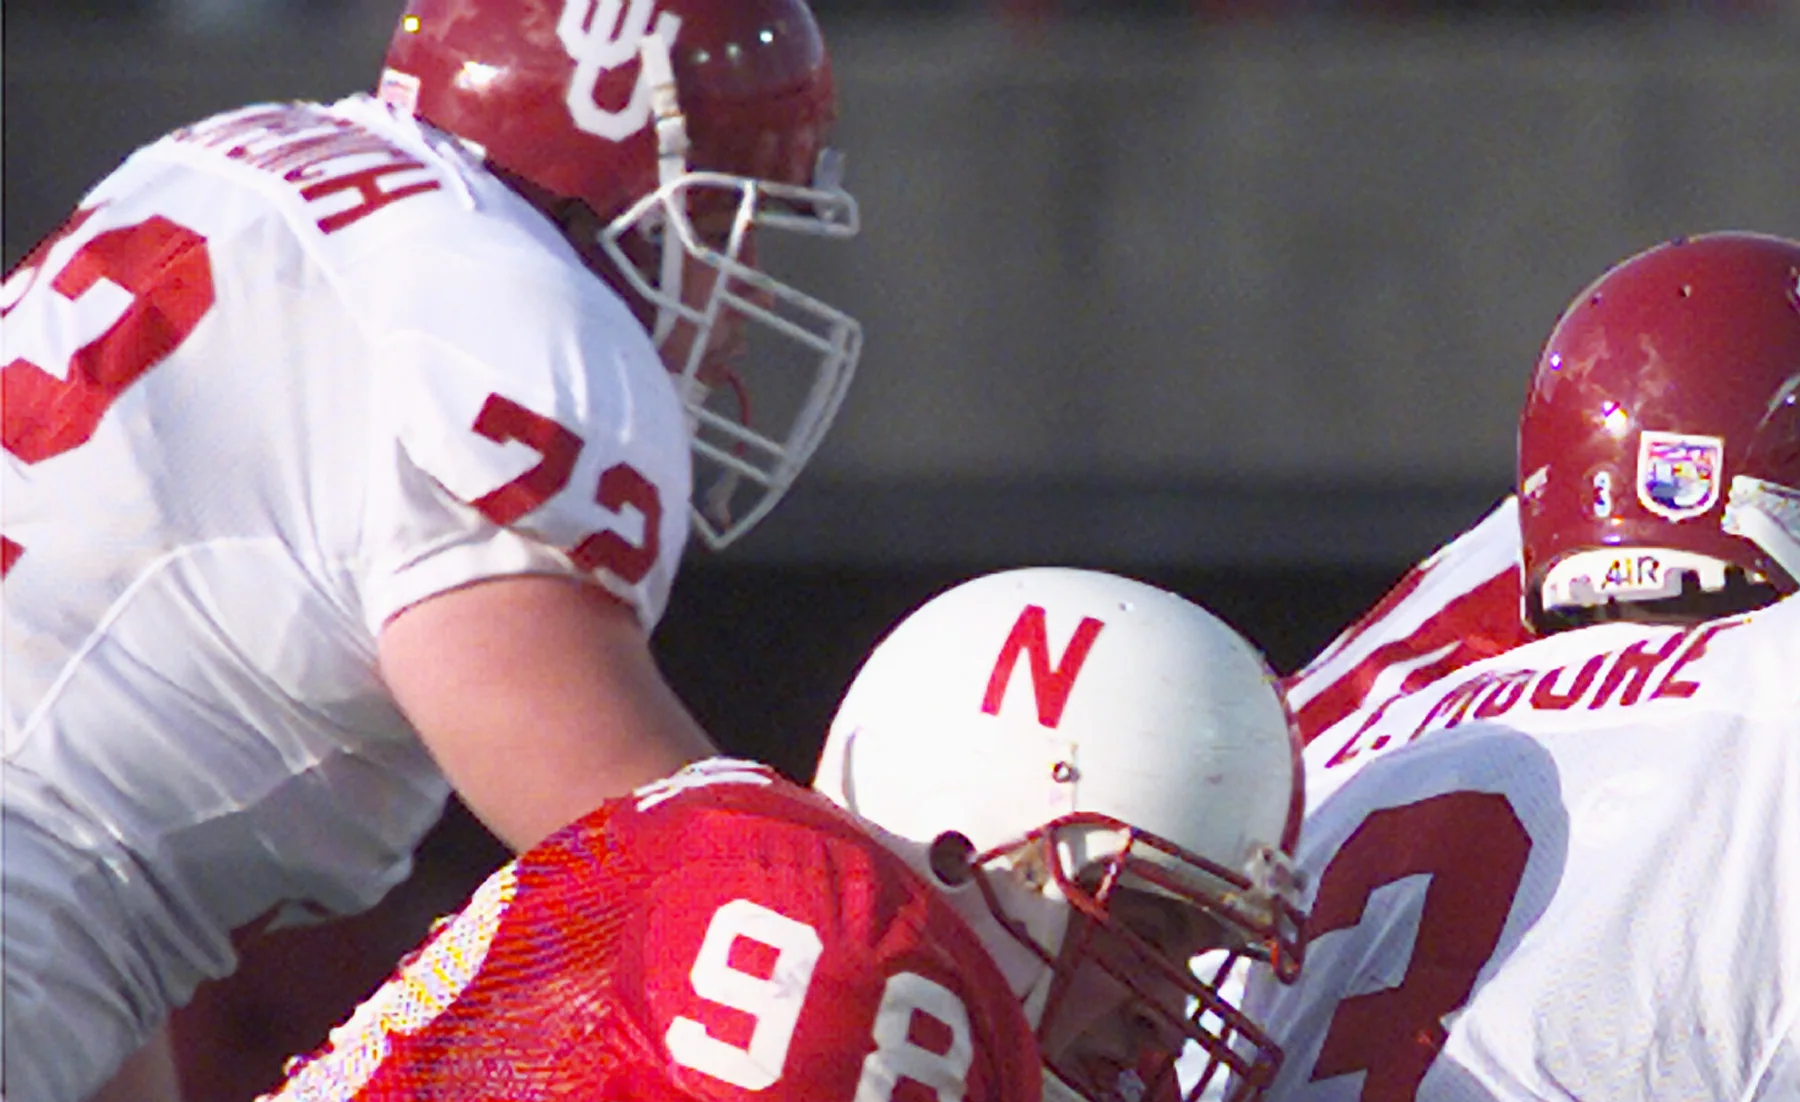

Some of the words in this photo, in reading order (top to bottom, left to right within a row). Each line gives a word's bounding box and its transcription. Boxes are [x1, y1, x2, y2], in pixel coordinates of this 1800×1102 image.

[471, 392, 664, 586] 72
[1593, 471, 1611, 518] 3
[1601, 556, 1657, 589] AIR
[980, 604, 1104, 728] N
